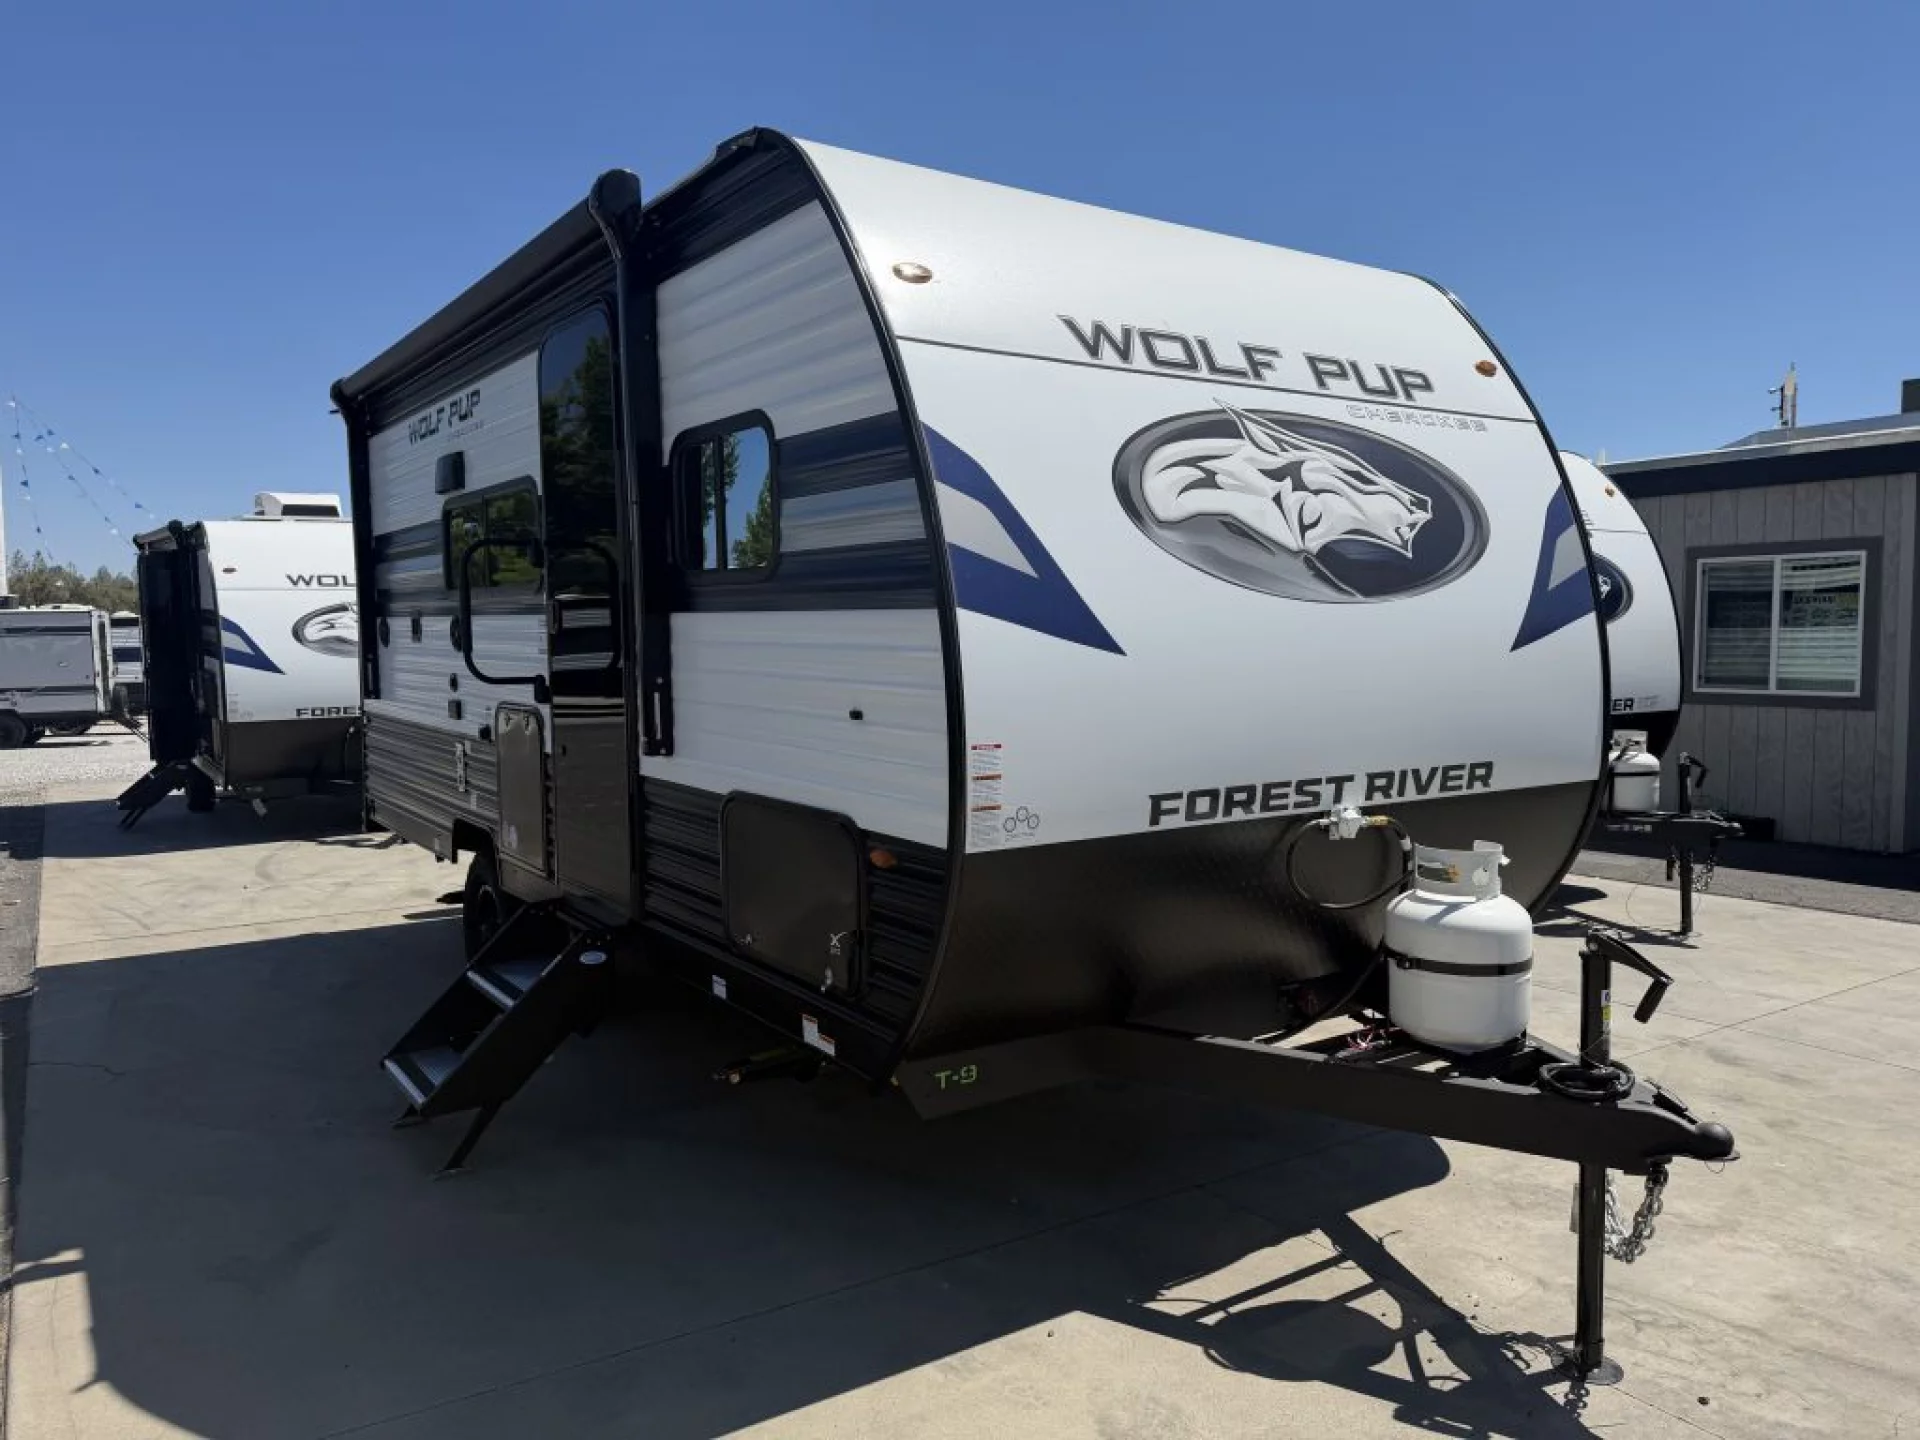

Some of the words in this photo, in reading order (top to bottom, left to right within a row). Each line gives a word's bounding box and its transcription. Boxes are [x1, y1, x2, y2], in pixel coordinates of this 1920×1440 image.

[1057, 314, 1283, 381] WOLF
[1303, 352, 1434, 401] PUP
[408, 405, 445, 446] WOLF
[447, 389, 481, 428] PUP
[1346, 404, 1487, 432] CHEROKEE
[295, 706, 361, 717] FORE
[1149, 774, 1355, 827] FOREST
[1365, 761, 1494, 801] RIVER
